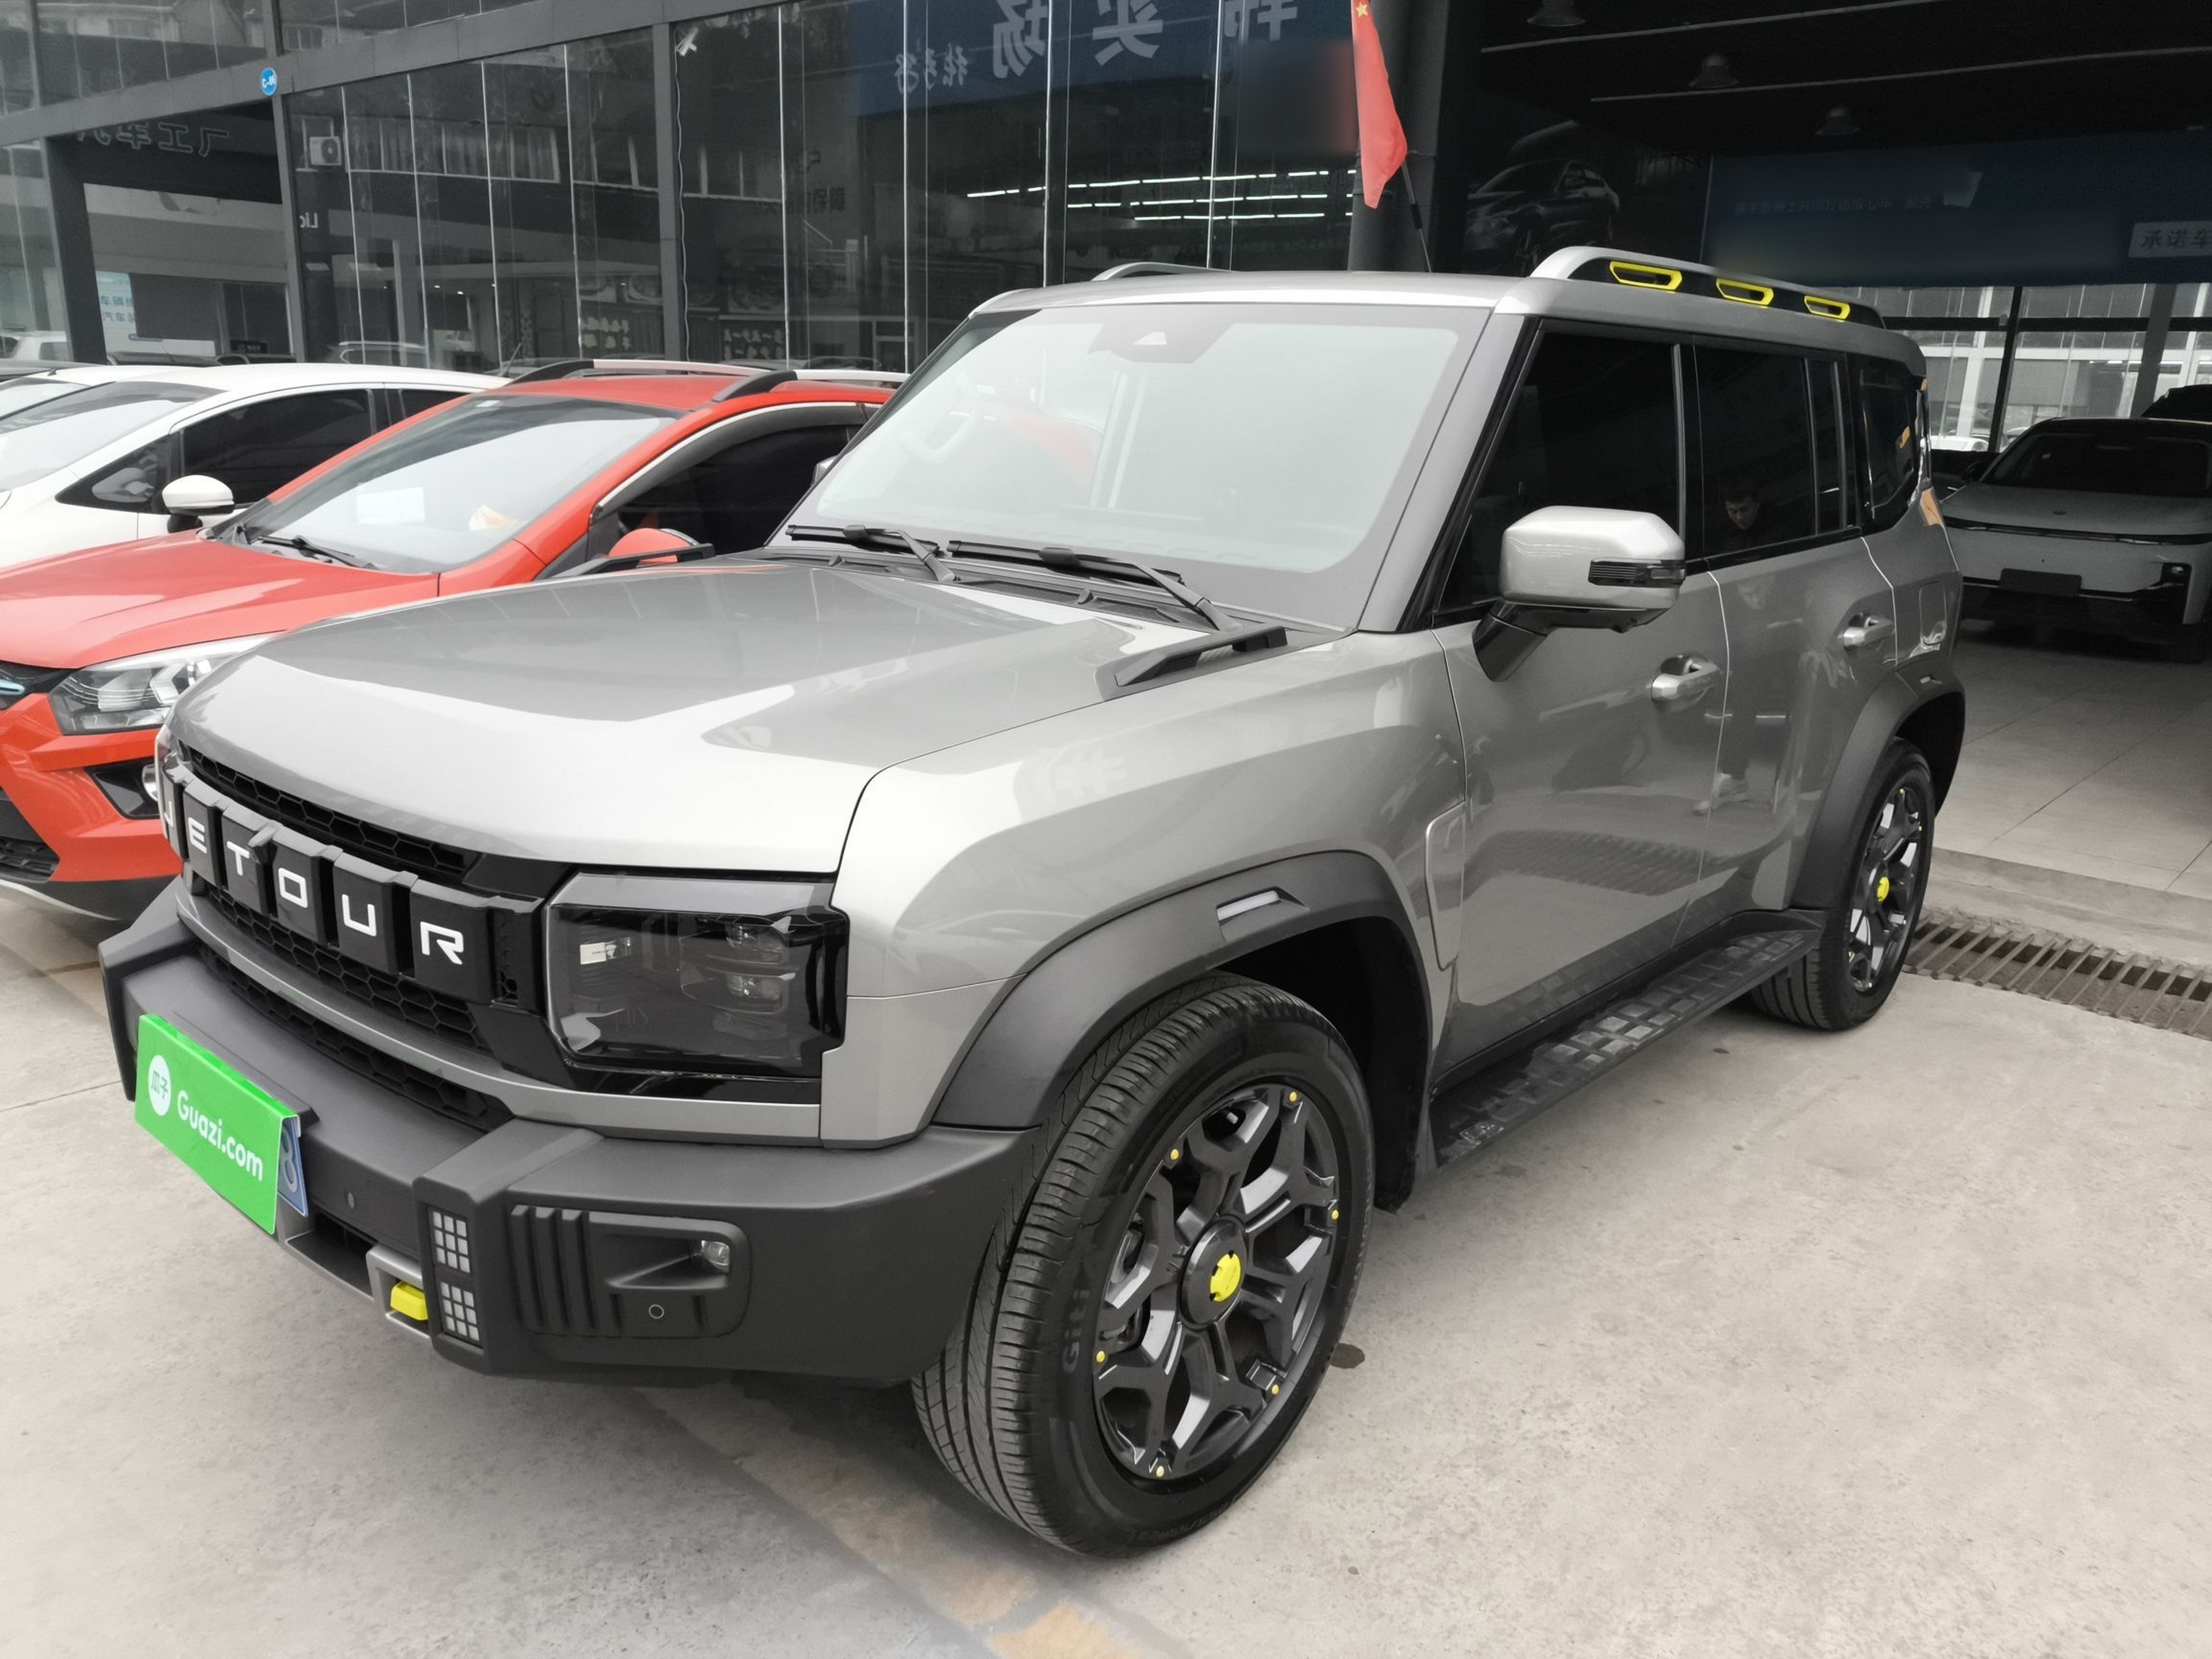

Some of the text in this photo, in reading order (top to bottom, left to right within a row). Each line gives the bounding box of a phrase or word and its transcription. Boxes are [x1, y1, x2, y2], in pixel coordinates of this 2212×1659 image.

[164, 801, 465, 965] JETOUR
[151, 1070, 169, 1099] 瓜子
[177, 1090, 264, 1181] Guazi.com
[1062, 1289, 1090, 1374] Giti
